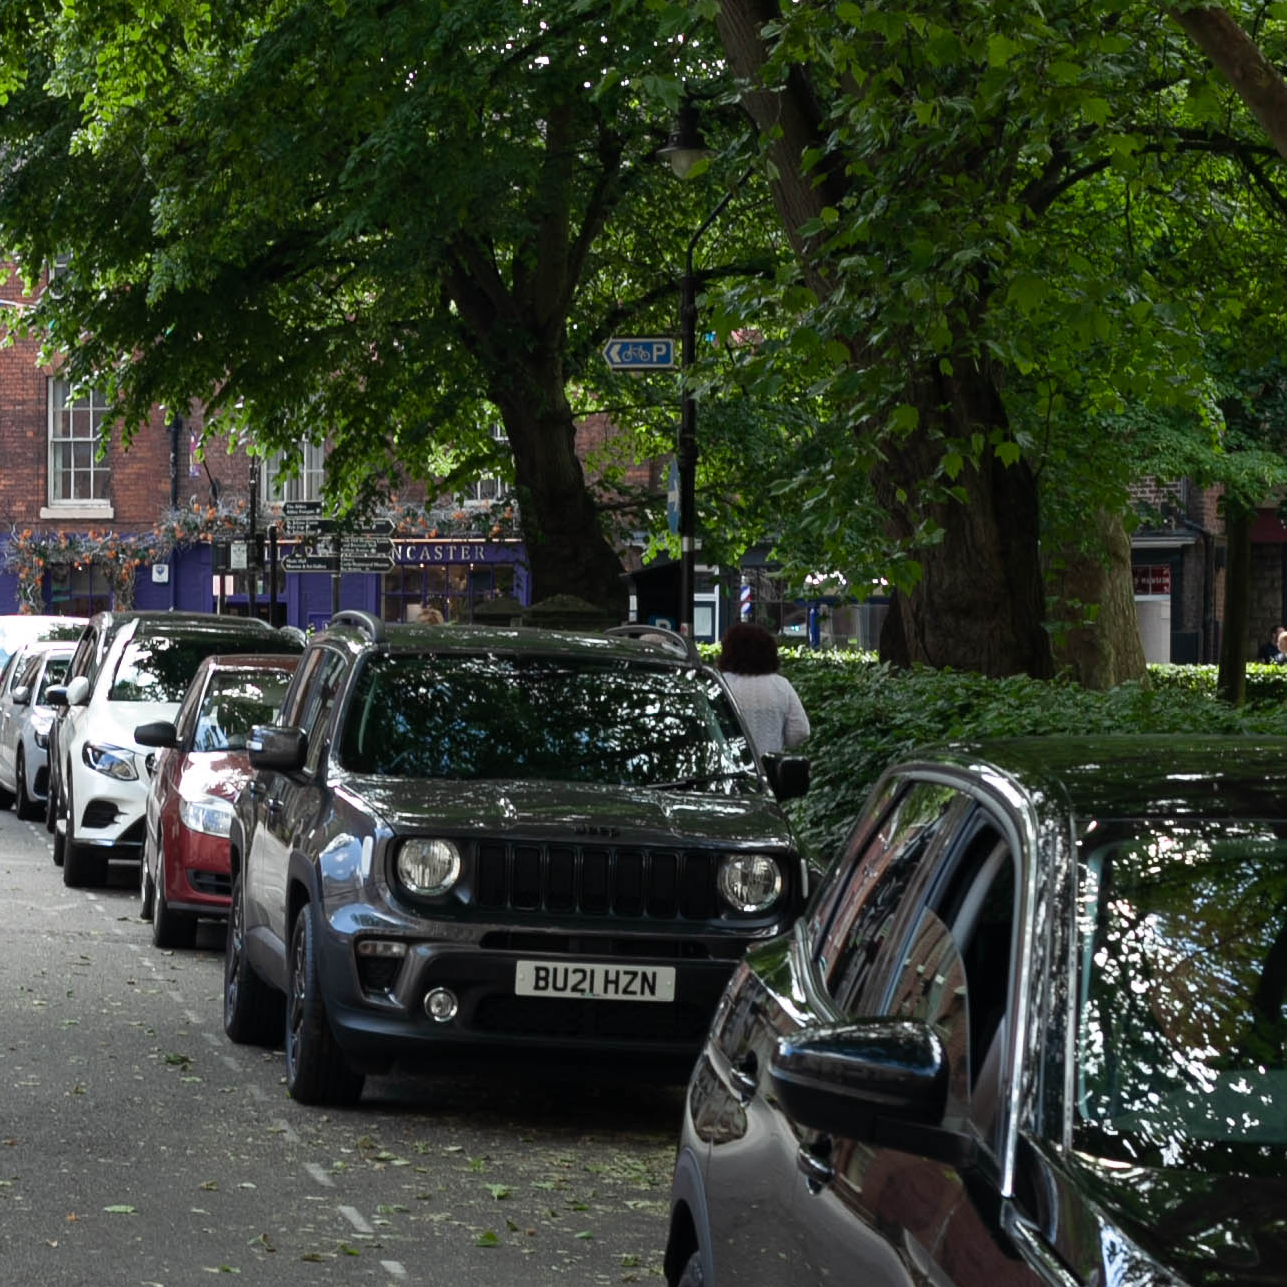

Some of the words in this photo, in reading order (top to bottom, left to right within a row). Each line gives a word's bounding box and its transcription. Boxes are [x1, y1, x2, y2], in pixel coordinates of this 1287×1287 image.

[653, 344, 667, 362] P
[391, 545, 485, 561] NCASTER
[533, 966, 595, 994] BU21
[603, 969, 657, 996] HZN
